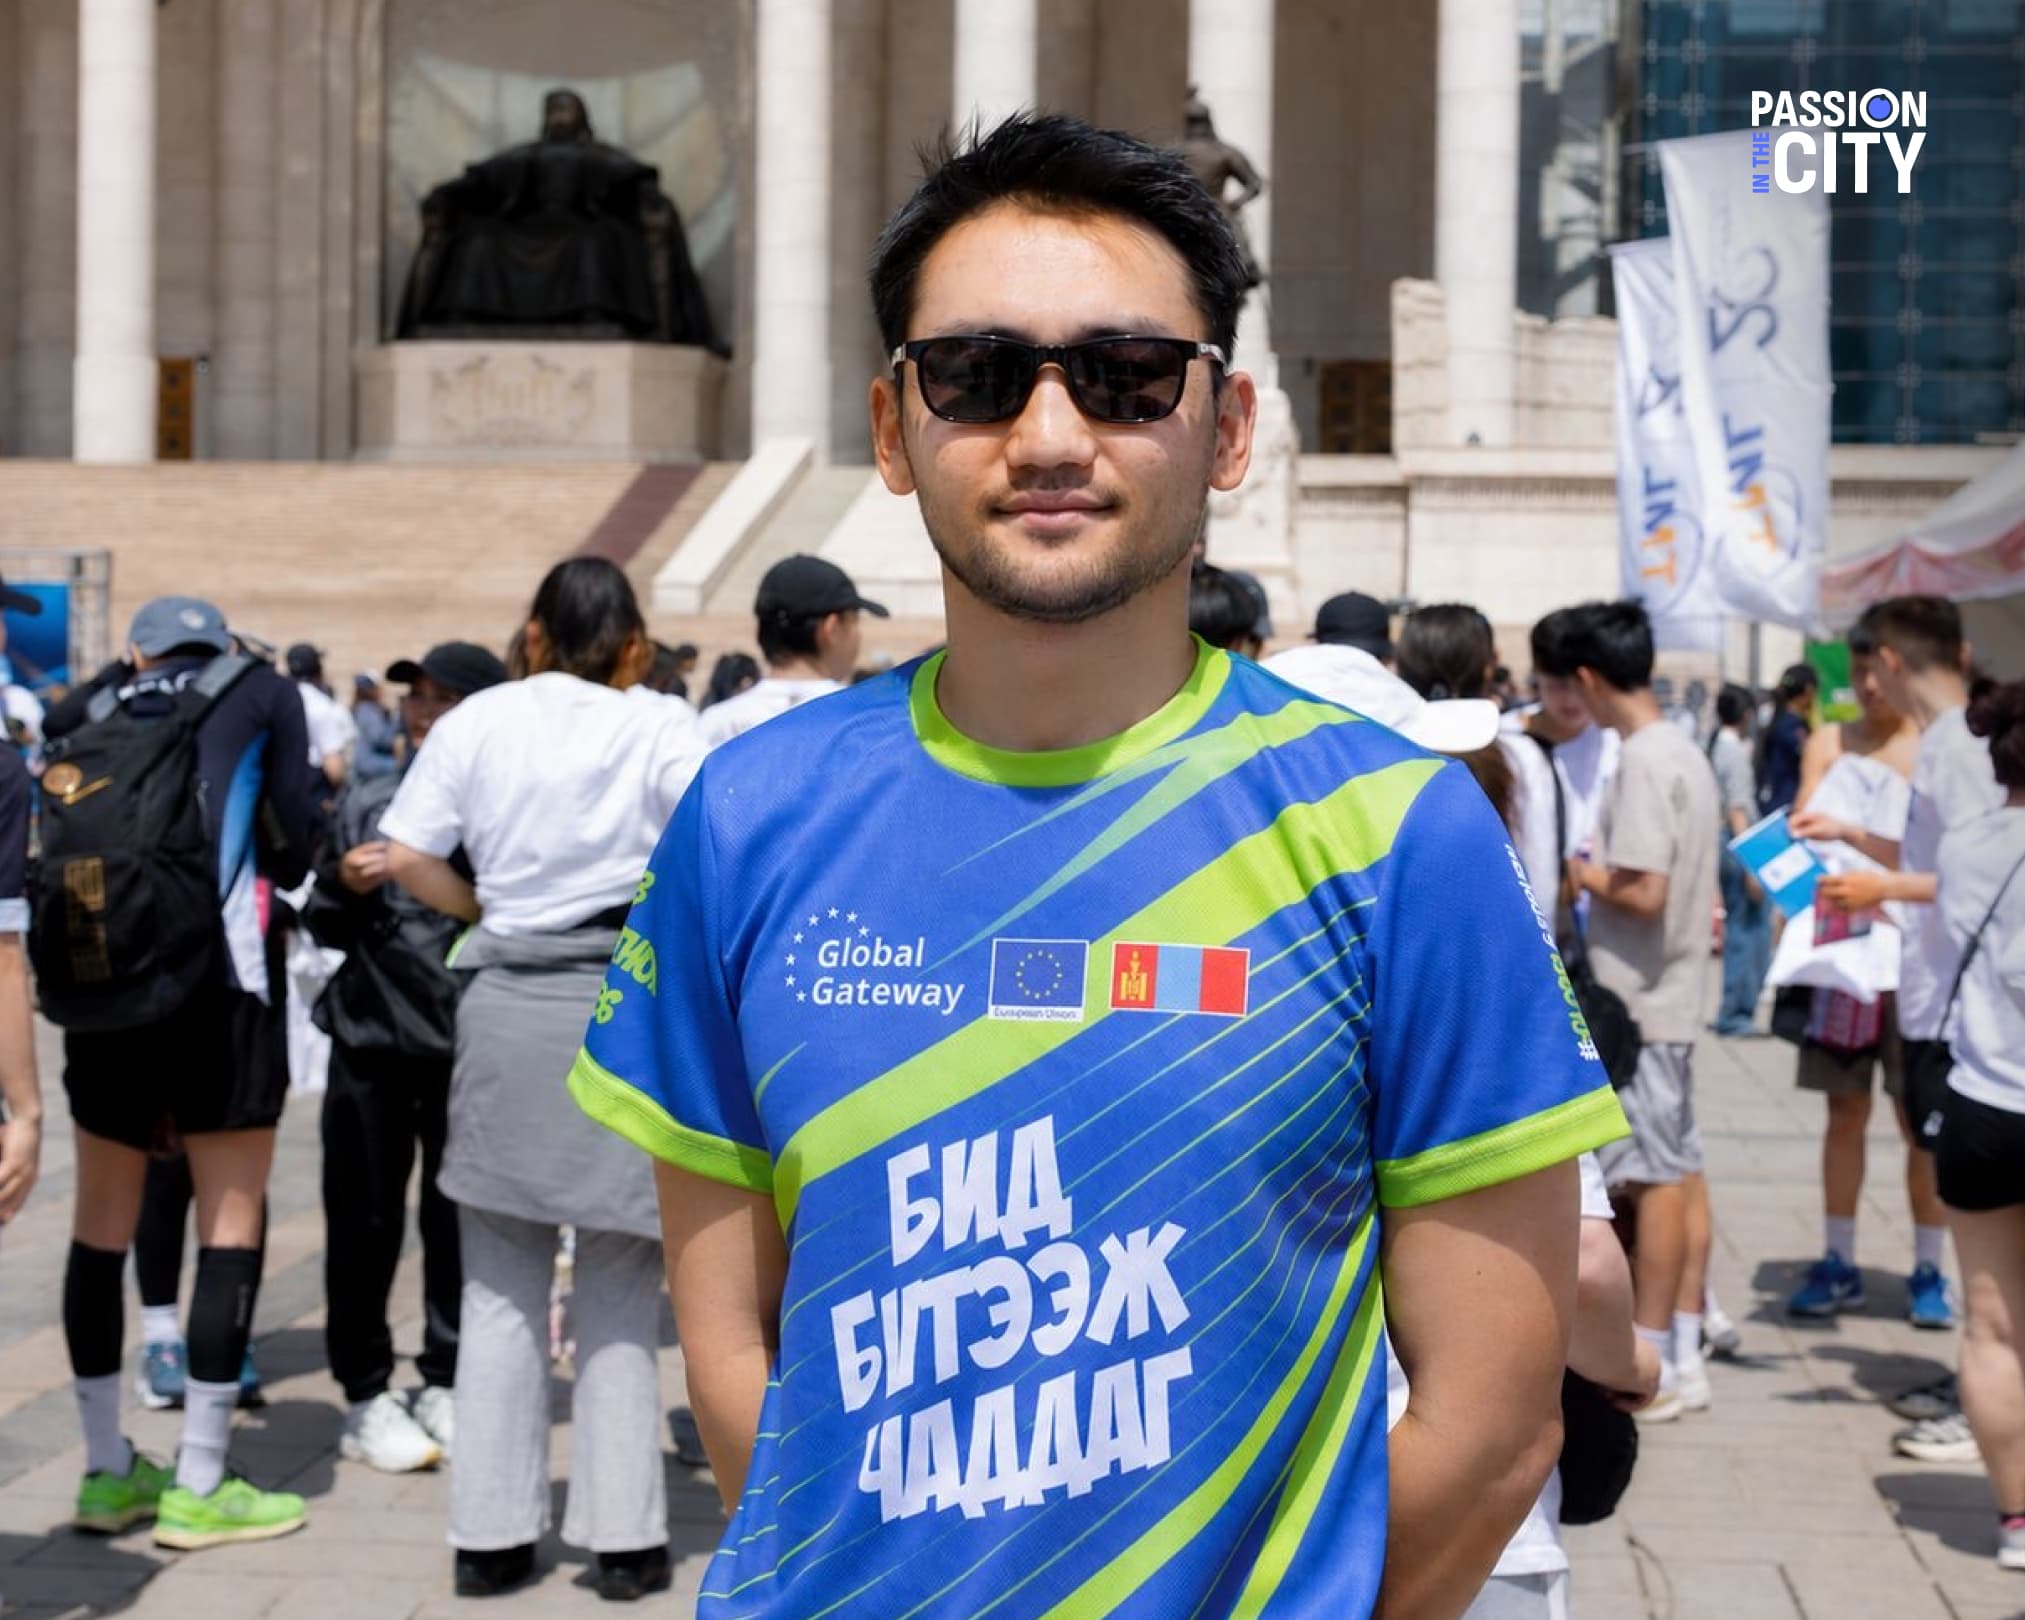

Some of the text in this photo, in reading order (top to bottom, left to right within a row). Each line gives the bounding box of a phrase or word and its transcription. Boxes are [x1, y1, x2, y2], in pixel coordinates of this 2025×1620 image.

[812, 975, 966, 1016] Gateway
[818, 936, 926, 968] Global
[886, 1113, 1073, 1268] БИД
[857, 1346, 1194, 1524] ЧАДДАГ
